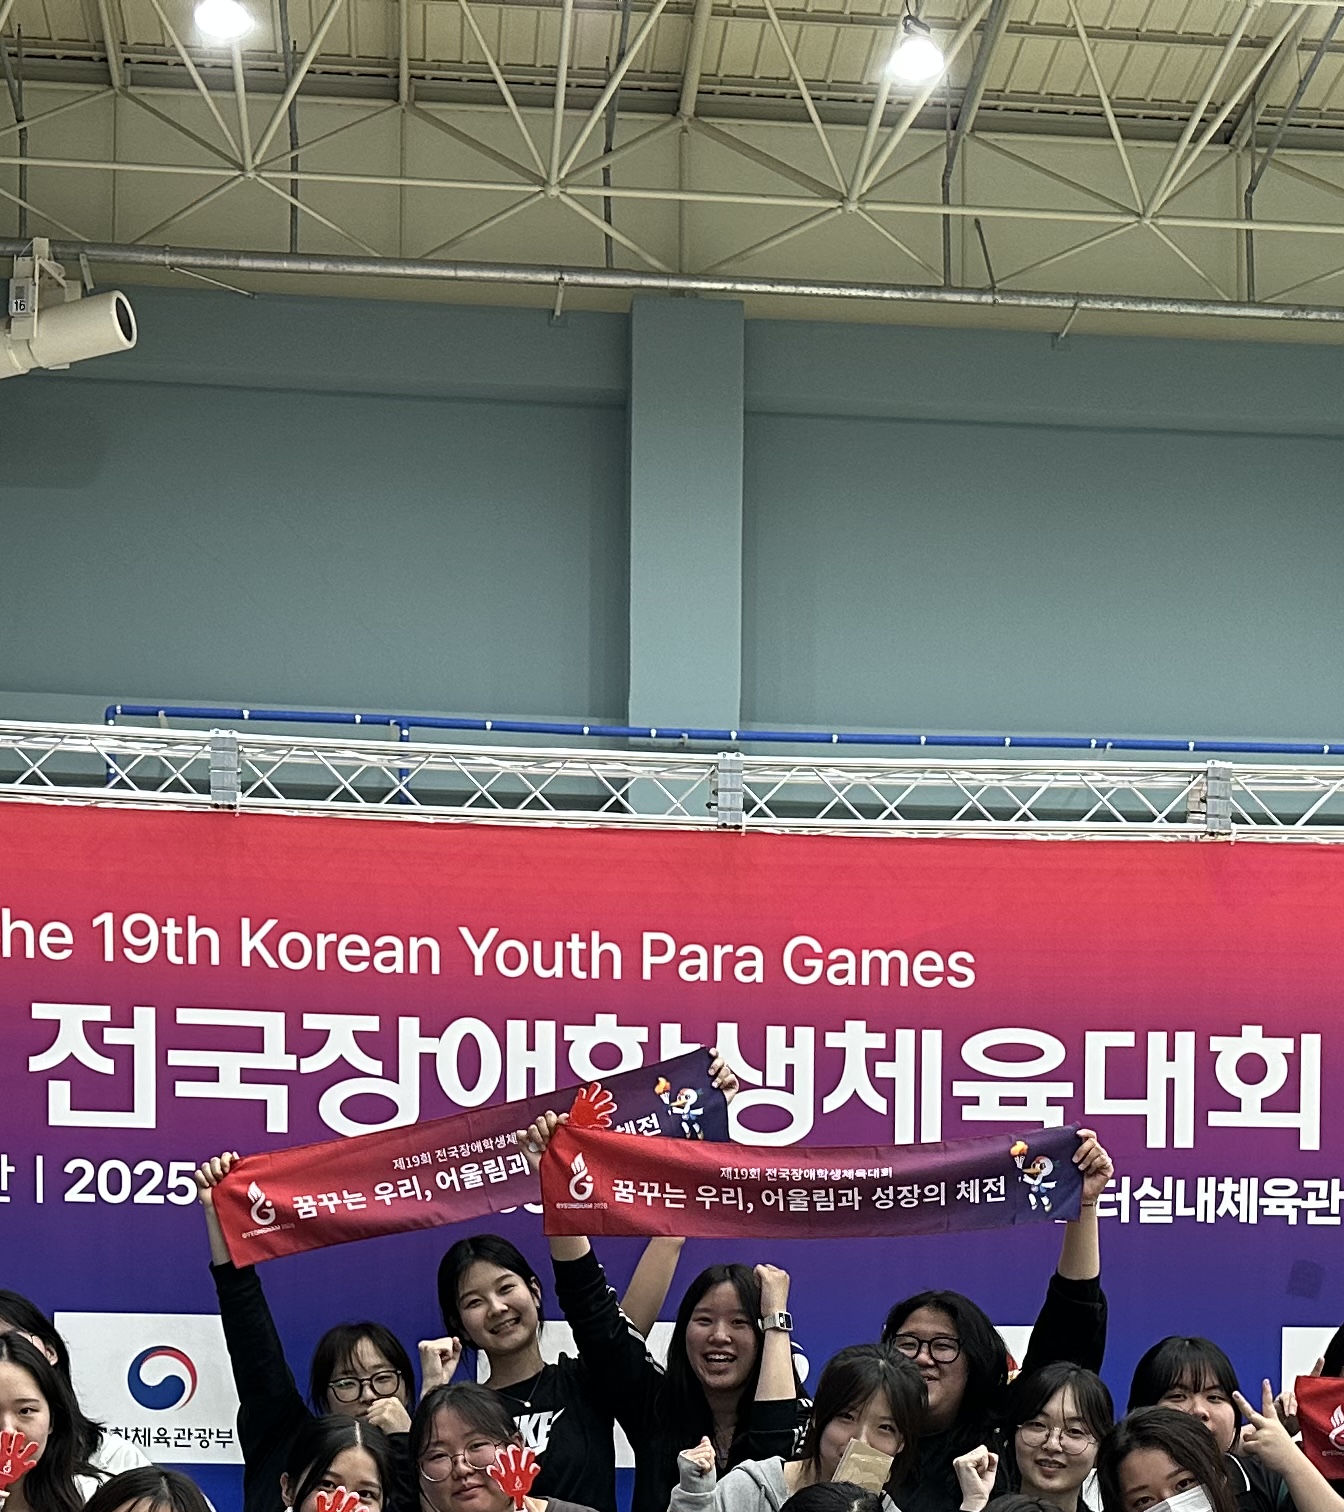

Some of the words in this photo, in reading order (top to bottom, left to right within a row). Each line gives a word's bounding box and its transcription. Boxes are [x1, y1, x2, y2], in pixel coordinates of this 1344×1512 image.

[92, 910, 222, 967] 19th
[240, 918, 441, 975] Korean
[459, 925, 623, 981] Youth
[642, 931, 765, 984] Para
[782, 936, 976, 989] Games
[28, 1003, 1322, 1151] 전국장애학생체육대회
[392, 1150, 433, 1172] 제19회
[435, 1131, 518, 1167] 전국장애학생체
[292, 1186, 368, 1221] 꿈꾸는
[374, 1176, 433, 1210] 우리,
[436, 1150, 531, 1193] 어울림과
[720, 1166, 761, 1181] 제19회
[764, 1166, 894, 1181] 전국장애학생체육대회
[612, 1180, 688, 1206] 꿈꾸는
[695, 1184, 754, 1214] 우리,
[761, 1186, 862, 1213] 어울림과
[871, 1182, 948, 1210] 성장의
[955, 1176, 1007, 1204] 체전
[108, 1427, 234, 1450] 화체육관광부
